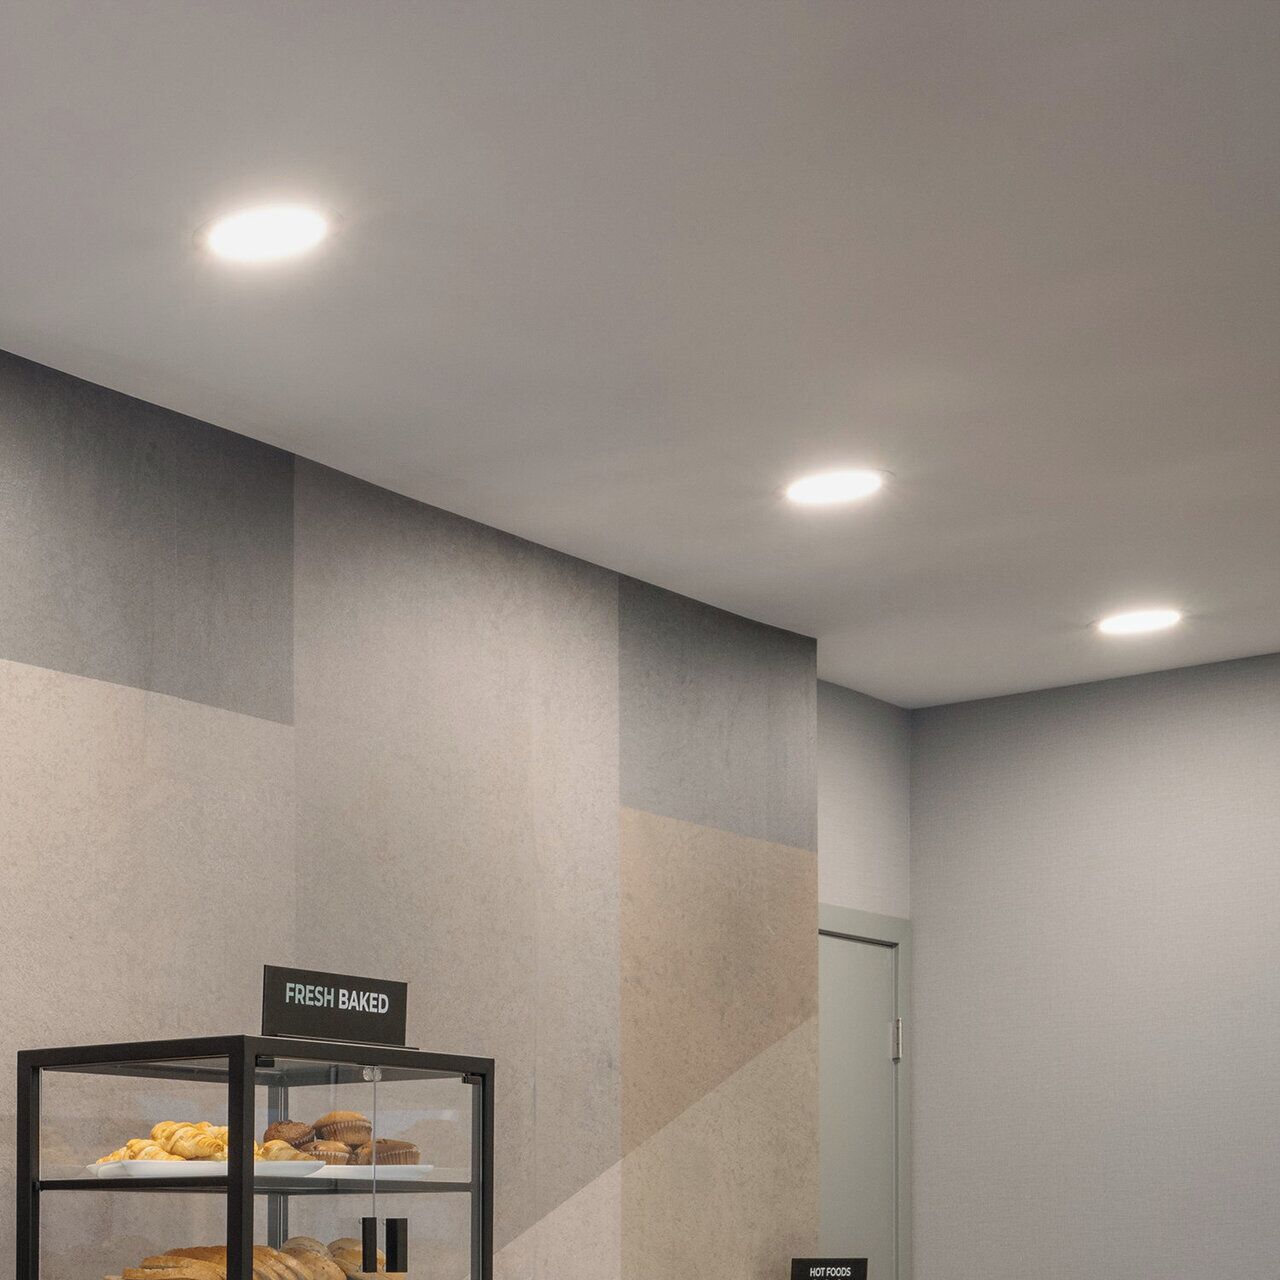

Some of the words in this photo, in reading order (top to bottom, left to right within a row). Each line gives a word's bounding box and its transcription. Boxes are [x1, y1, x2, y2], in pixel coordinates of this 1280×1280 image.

[286, 983, 334, 1007] FRESH
[339, 989, 388, 1013] BAKED
[810, 1267, 825, 1276] HOT
[826, 1267, 851, 1276] FOODS
